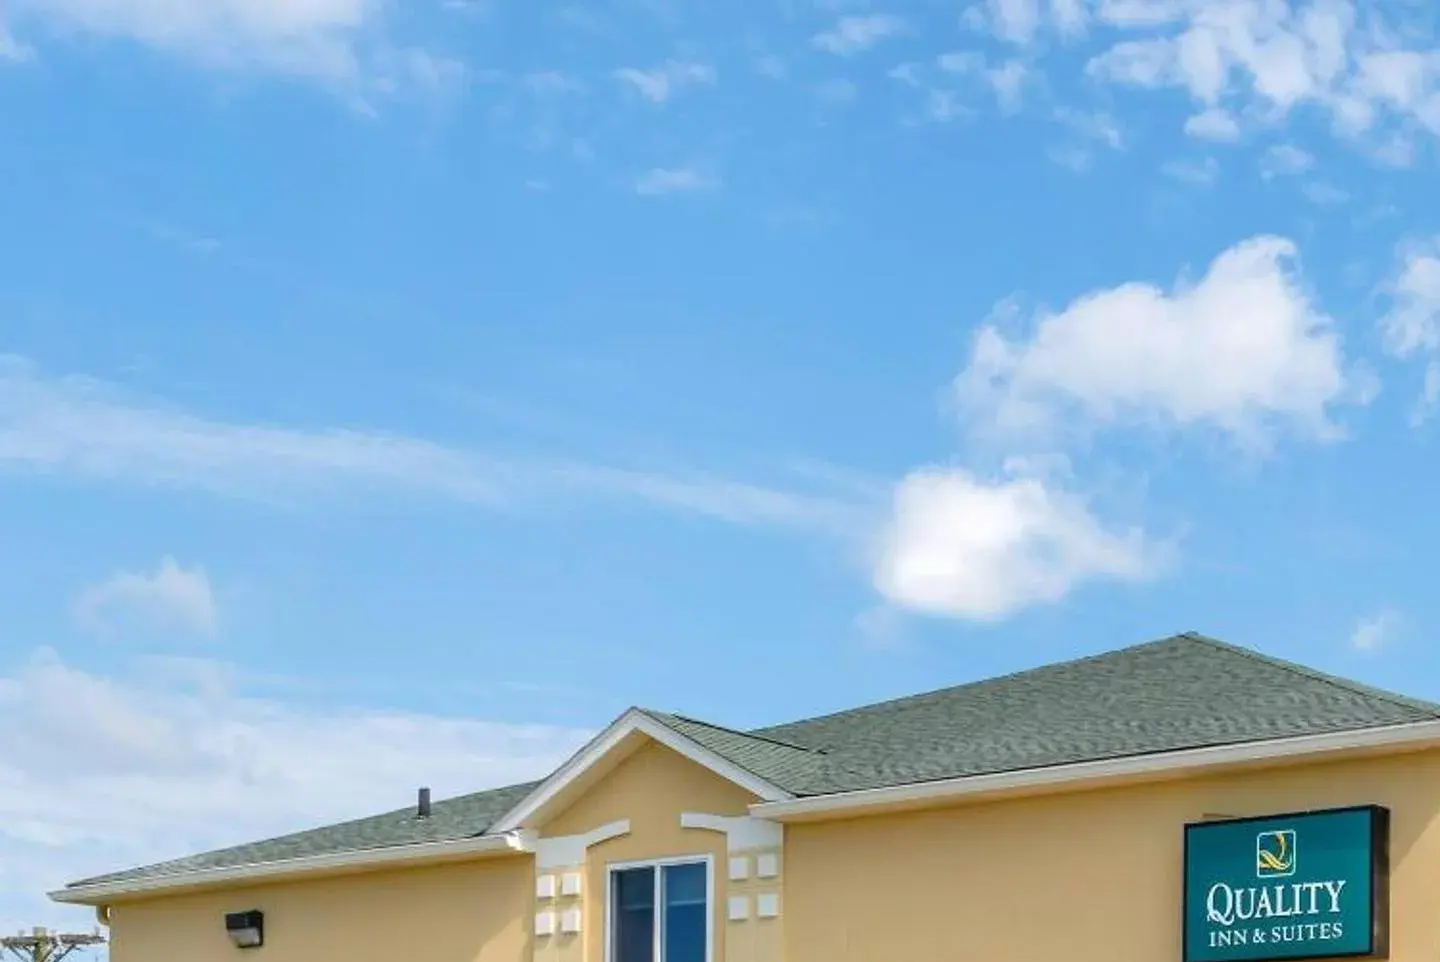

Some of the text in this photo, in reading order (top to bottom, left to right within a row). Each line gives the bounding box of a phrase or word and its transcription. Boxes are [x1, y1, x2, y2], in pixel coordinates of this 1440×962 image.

[1206, 881, 1346, 926] QUALITY
[1208, 922, 1343, 947] INN & SUITES
